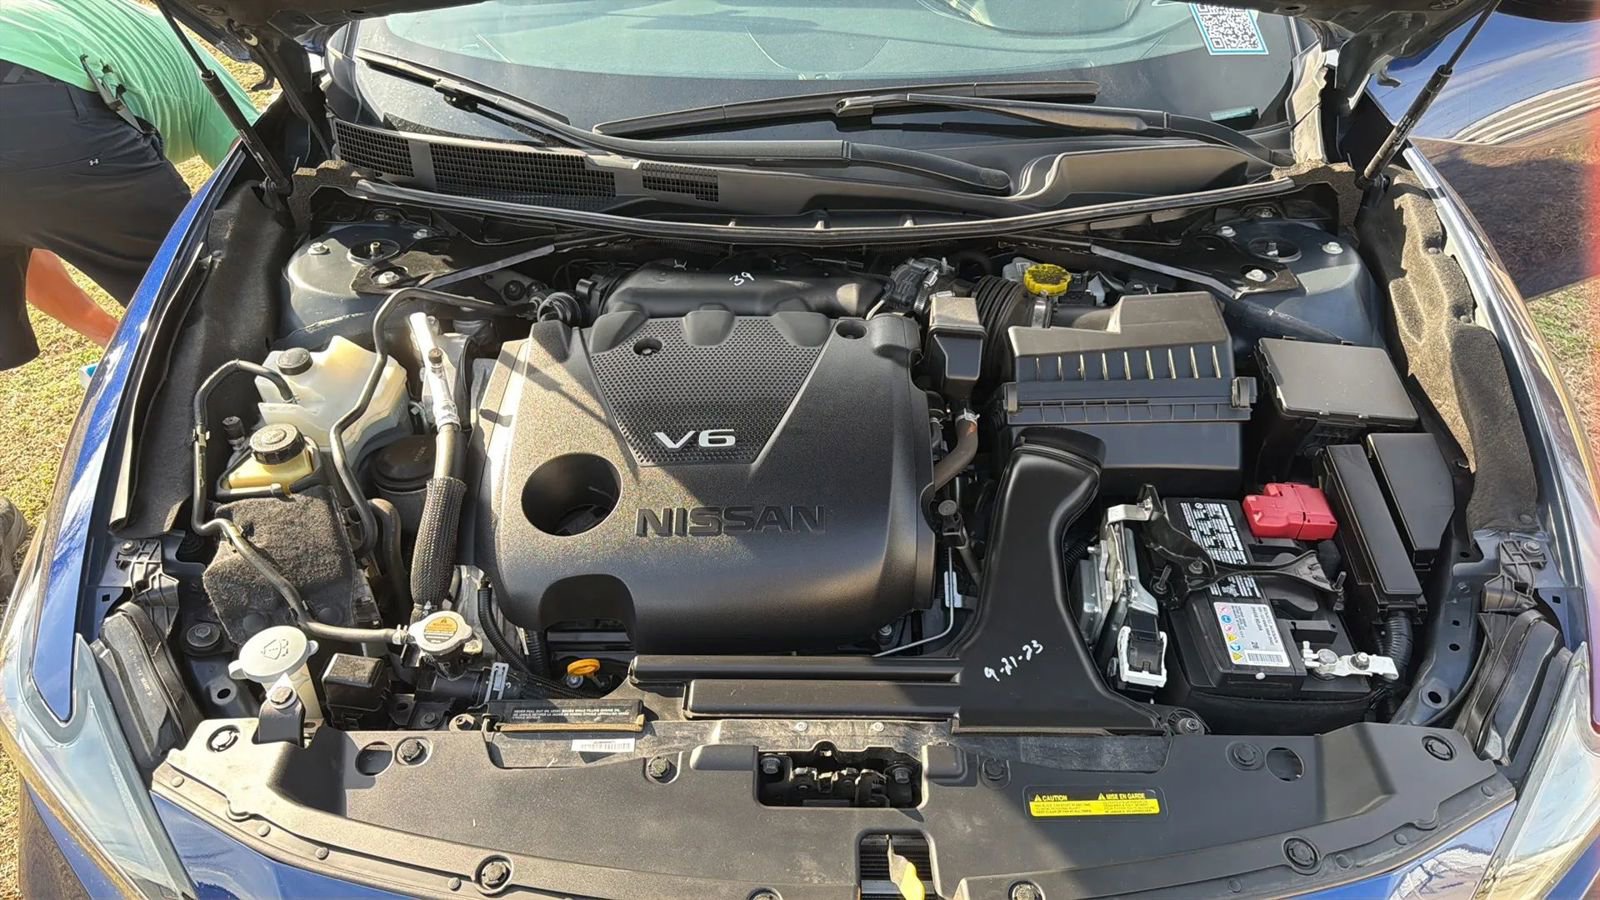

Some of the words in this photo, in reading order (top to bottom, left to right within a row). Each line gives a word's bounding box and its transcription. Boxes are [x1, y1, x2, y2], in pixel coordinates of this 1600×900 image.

[728, 271, 755, 286] 39
[654, 428, 736, 450] V6
[635, 504, 826, 538] NISSAN
[1041, 794, 1068, 802] CAUTION
